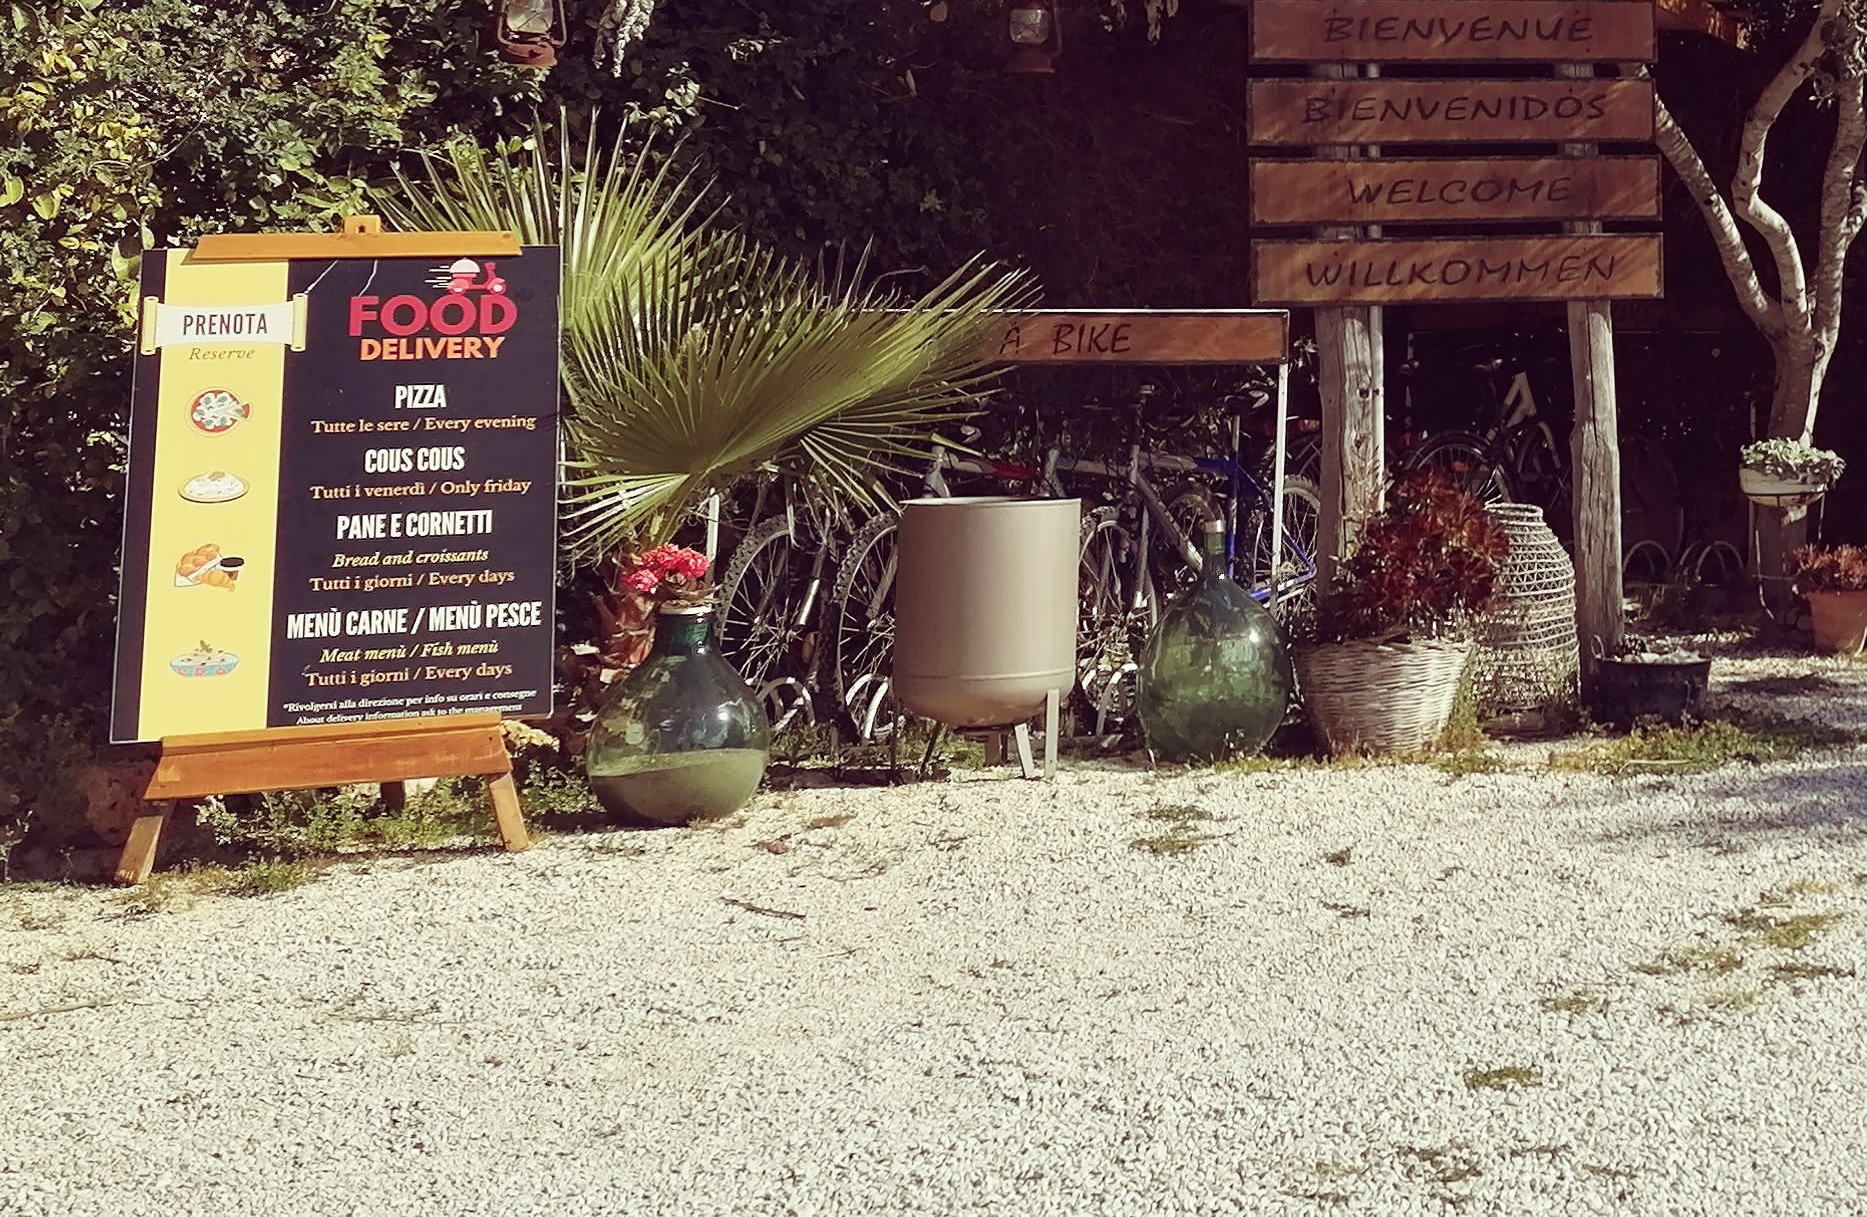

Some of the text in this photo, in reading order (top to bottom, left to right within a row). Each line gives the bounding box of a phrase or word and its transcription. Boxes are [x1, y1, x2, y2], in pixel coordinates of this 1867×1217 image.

[1323, 15, 1594, 43] BIENVENUE
[1302, 95, 1607, 124] BIENVENIDOS
[1347, 177, 1572, 205] WELCOME
[1305, 256, 1617, 286] WILLKOMMEN
[183, 312, 268, 335] PRENOTA
[349, 294, 518, 336] FOOD
[360, 336, 505, 361] DELIVERY
[1000, 321, 1132, 355] A BIKE
[188, 347, 256, 361] Reserve
[395, 384, 447, 409] PIZZA
[311, 419, 355, 433] Tutte
[359, 419, 373, 432] le
[376, 420, 409, 432] sere
[424, 417, 471, 433] Every
[474, 414, 536, 430] evening
[365, 446, 466, 473] COUS COUS
[310, 485, 351, 500] Tutti
[363, 482, 425, 498] venerdì
[440, 480, 481, 497] Only
[484, 478, 532, 494] friday
[336, 509, 493, 540] PANE E CORNETTI
[332, 549, 489, 569] Bread and croissants
[310, 577, 351, 592] Tutti
[363, 575, 413, 593] giorni
[428, 571, 476, 588] Every
[478, 569, 516, 586] days
[287, 601, 542, 639] MENÙ CARNE / MENÙ PESCE
[319, 647, 360, 664] Meat
[363, 644, 407, 662] menù
[421, 641, 453, 658] Fish
[456, 639, 499, 655] menù
[305, 671, 346, 687] Tutti
[360, 668, 409, 687] giorni
[425, 665, 472, 683] Every
[475, 662, 513, 680] days
[339, 699, 356, 710] alla
[358, 696, 404, 709] direzione
[405, 696, 424, 707] per
[425, 693, 445, 704] info
[296, 716, 325, 725] About
